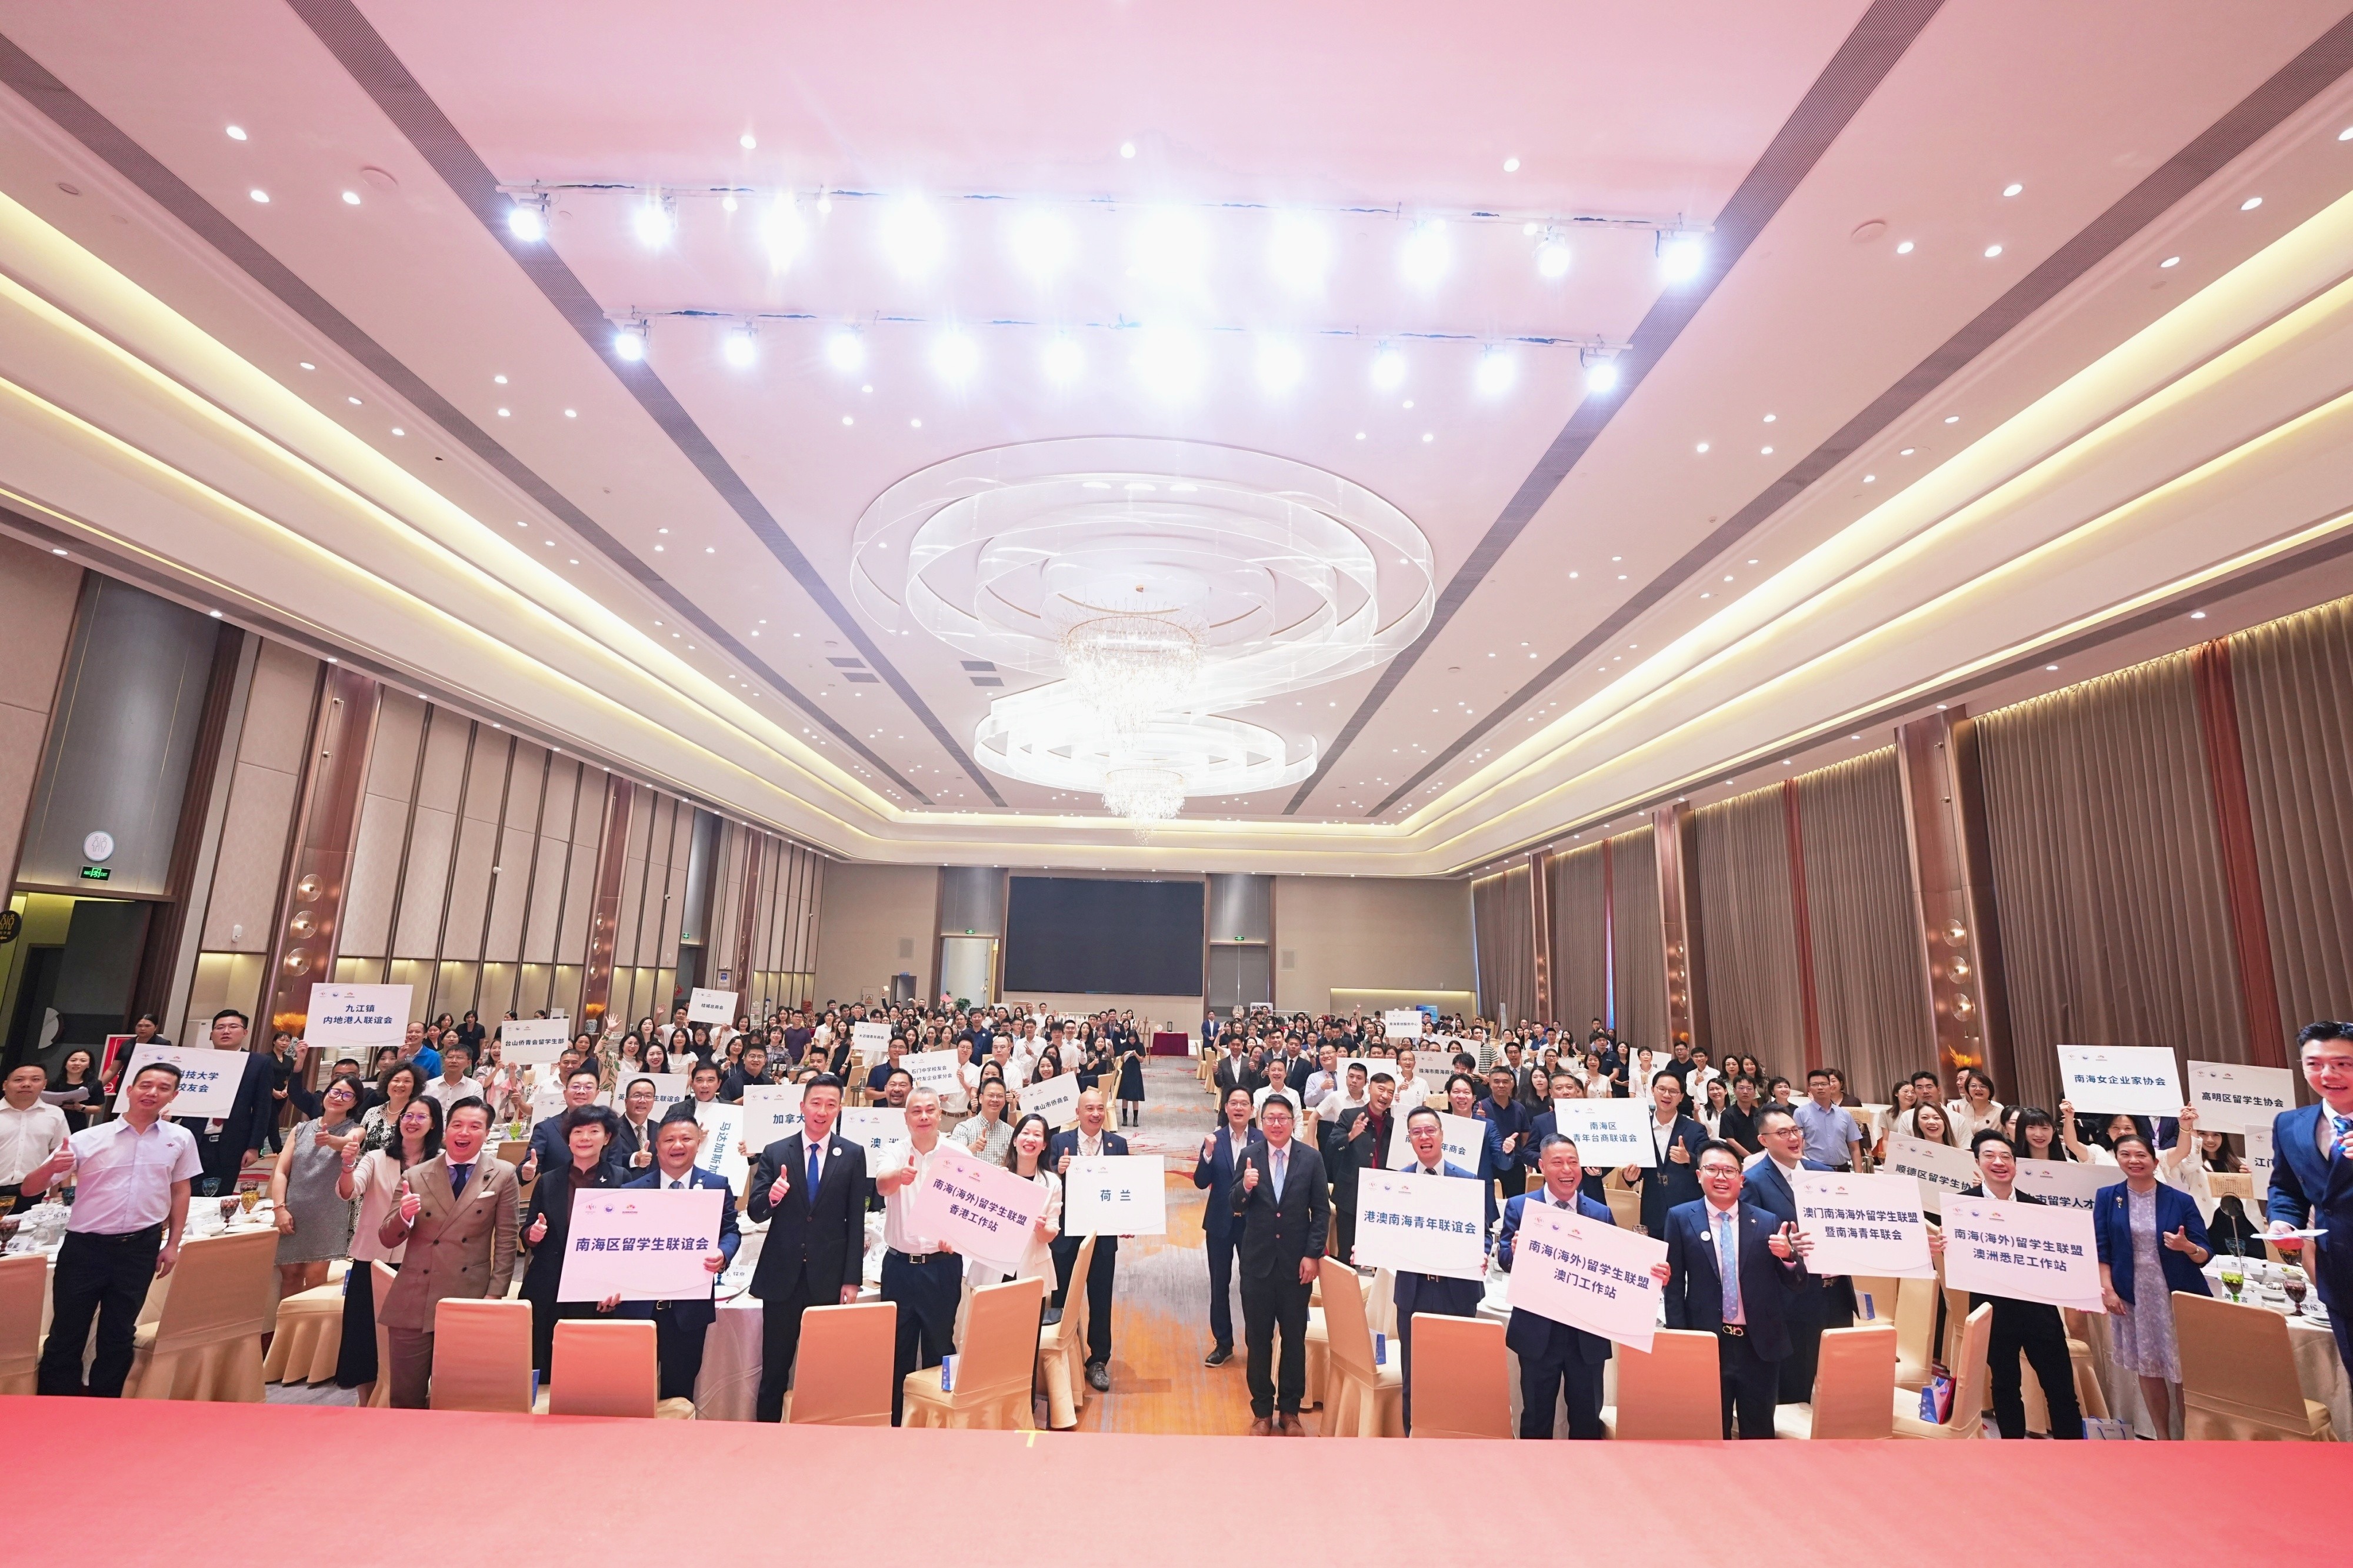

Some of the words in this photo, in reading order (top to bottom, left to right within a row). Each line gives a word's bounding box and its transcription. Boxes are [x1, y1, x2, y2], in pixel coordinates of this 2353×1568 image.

[323, 1016, 392, 1024] 内地港人联谊会
[505, 1038, 564, 1046] 台山侨青会留学生部
[912, 1065, 947, 1074] 石门中学校友会
[2074, 1075, 2166, 1086] 南海女企业家协会
[1034, 1095, 1069, 1112] 佛山市侨商会
[2201, 1092, 2284, 1107] 高明区留学生协会
[773, 1113, 805, 1124] 加拿大
[1589, 1122, 1617, 1130] 南海区
[1573, 1134, 1637, 1142] 青年台商联谊会
[933, 1178, 1028, 1226] 南海(海外)留学生联盟
[2028, 1193, 2095, 1209] 市留学人才
[949, 1203, 999, 1232] 香港工作站
[1364, 1210, 1476, 1235] 港澳南海青年联谊会
[1803, 1207, 1919, 1223] 澳门南海海外留学生联盟
[1825, 1226, 1902, 1240] 暨南海青年联会
[575, 1237, 709, 1252] 南海区留学生联谊会
[1954, 1228, 2084, 1256] 南海(海外)留学生联盟
[1528, 1240, 1649, 1290] 南海(海外)留学生联盟
[1973, 1247, 2067, 1272] 澳洲悉尼工作站
[1554, 1268, 1617, 1299] 澳门工作站
